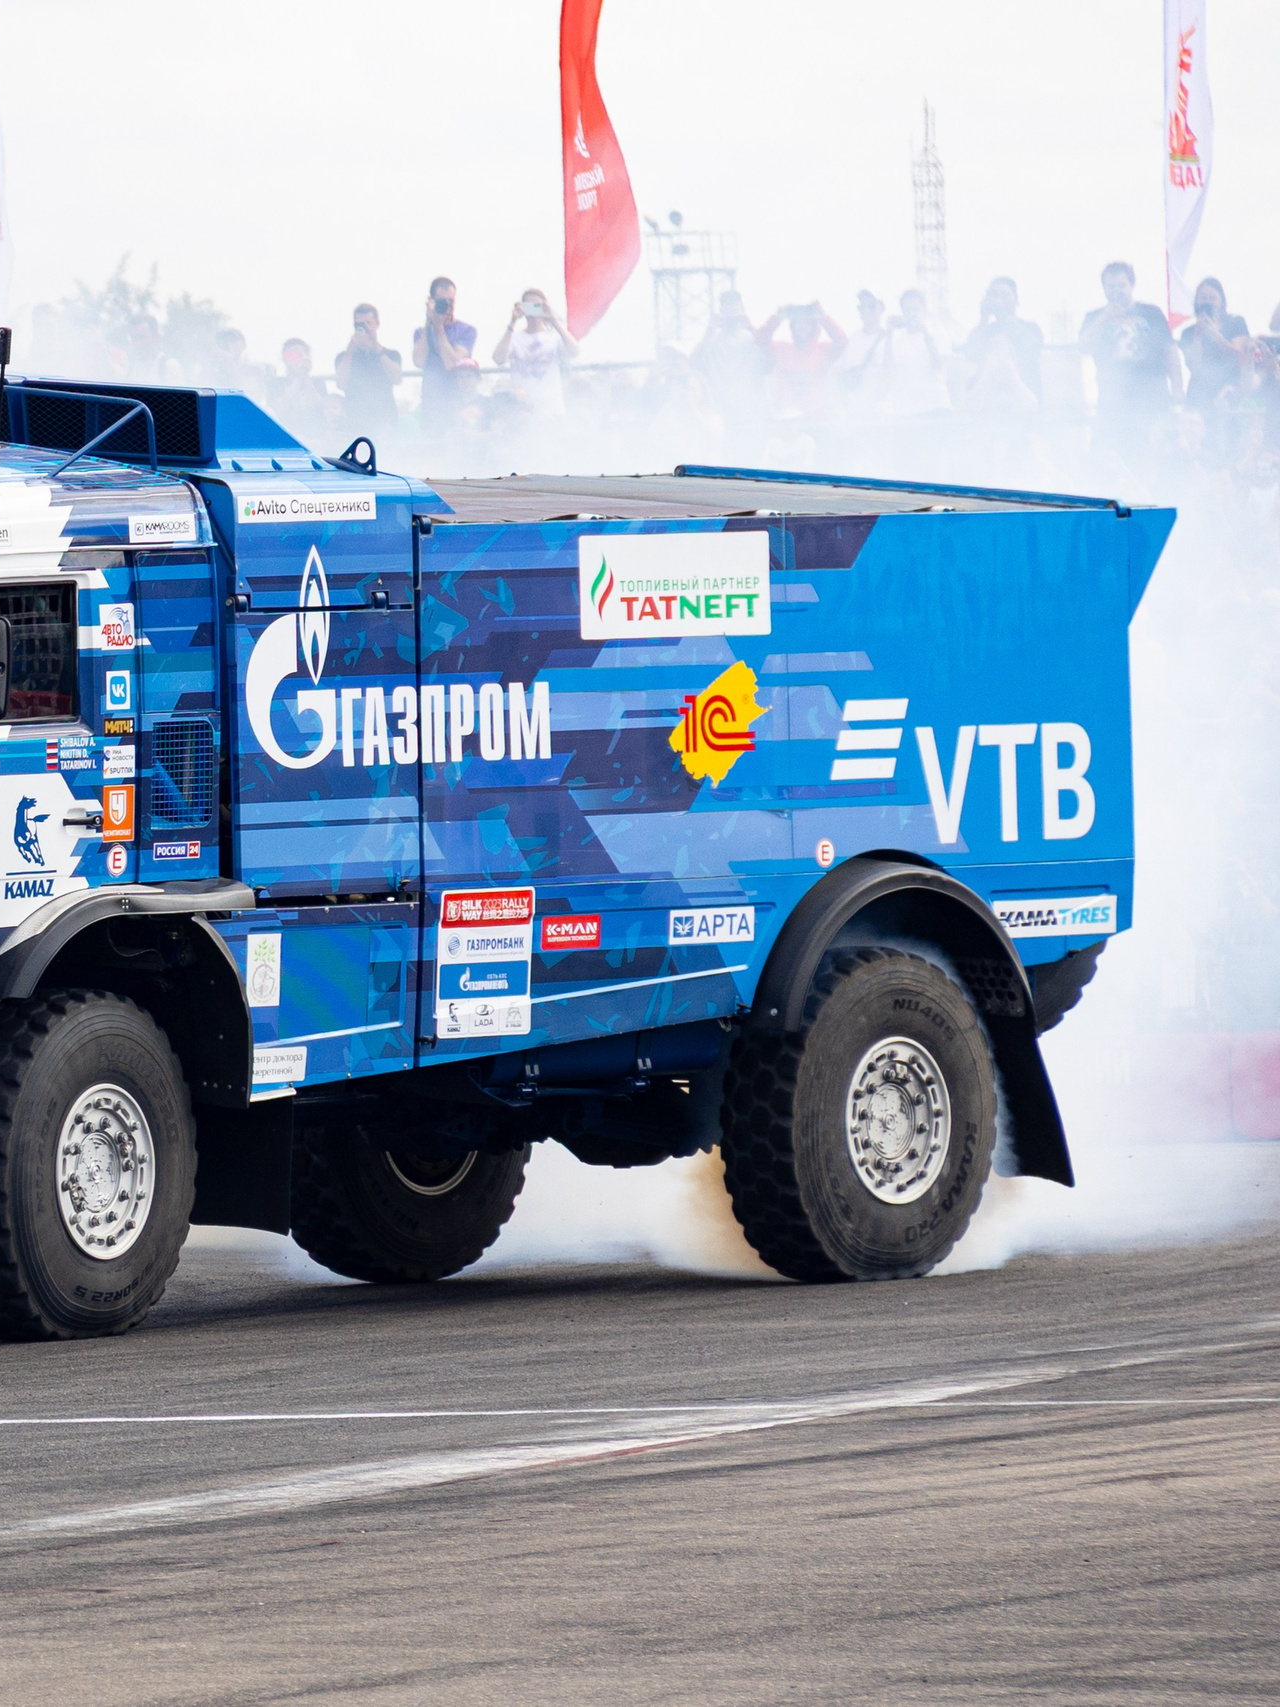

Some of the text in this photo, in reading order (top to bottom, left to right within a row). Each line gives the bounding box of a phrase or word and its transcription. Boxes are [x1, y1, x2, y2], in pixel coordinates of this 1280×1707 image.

[257, 499, 371, 516] Avito Спецтехника
[620, 576, 760, 593] ТОПЛИВНЫЙ ПАРТНЕР
[620, 593, 760, 621] TATNEFT
[101, 623, 122, 636] АВТО
[107, 633, 134, 647] РАДИО
[112, 686, 125, 698] VK
[105, 720, 133, 734] МАТЧ!
[341, 681, 552, 768] ГАЗПРОМ
[914, 722, 1096, 845] VTB
[157, 846, 186, 856] РОССИЯ
[4, 879, 54, 900] KAMAZ
[461, 899, 482, 910] SILK
[502, 897, 529, 909] RALLY
[462, 910, 482, 920] WAY
[467, 937, 524, 951] ГАЗПРОМБАНК
[474, 1018, 494, 1028] LADA
[253, 1056, 271, 1065] ентр
